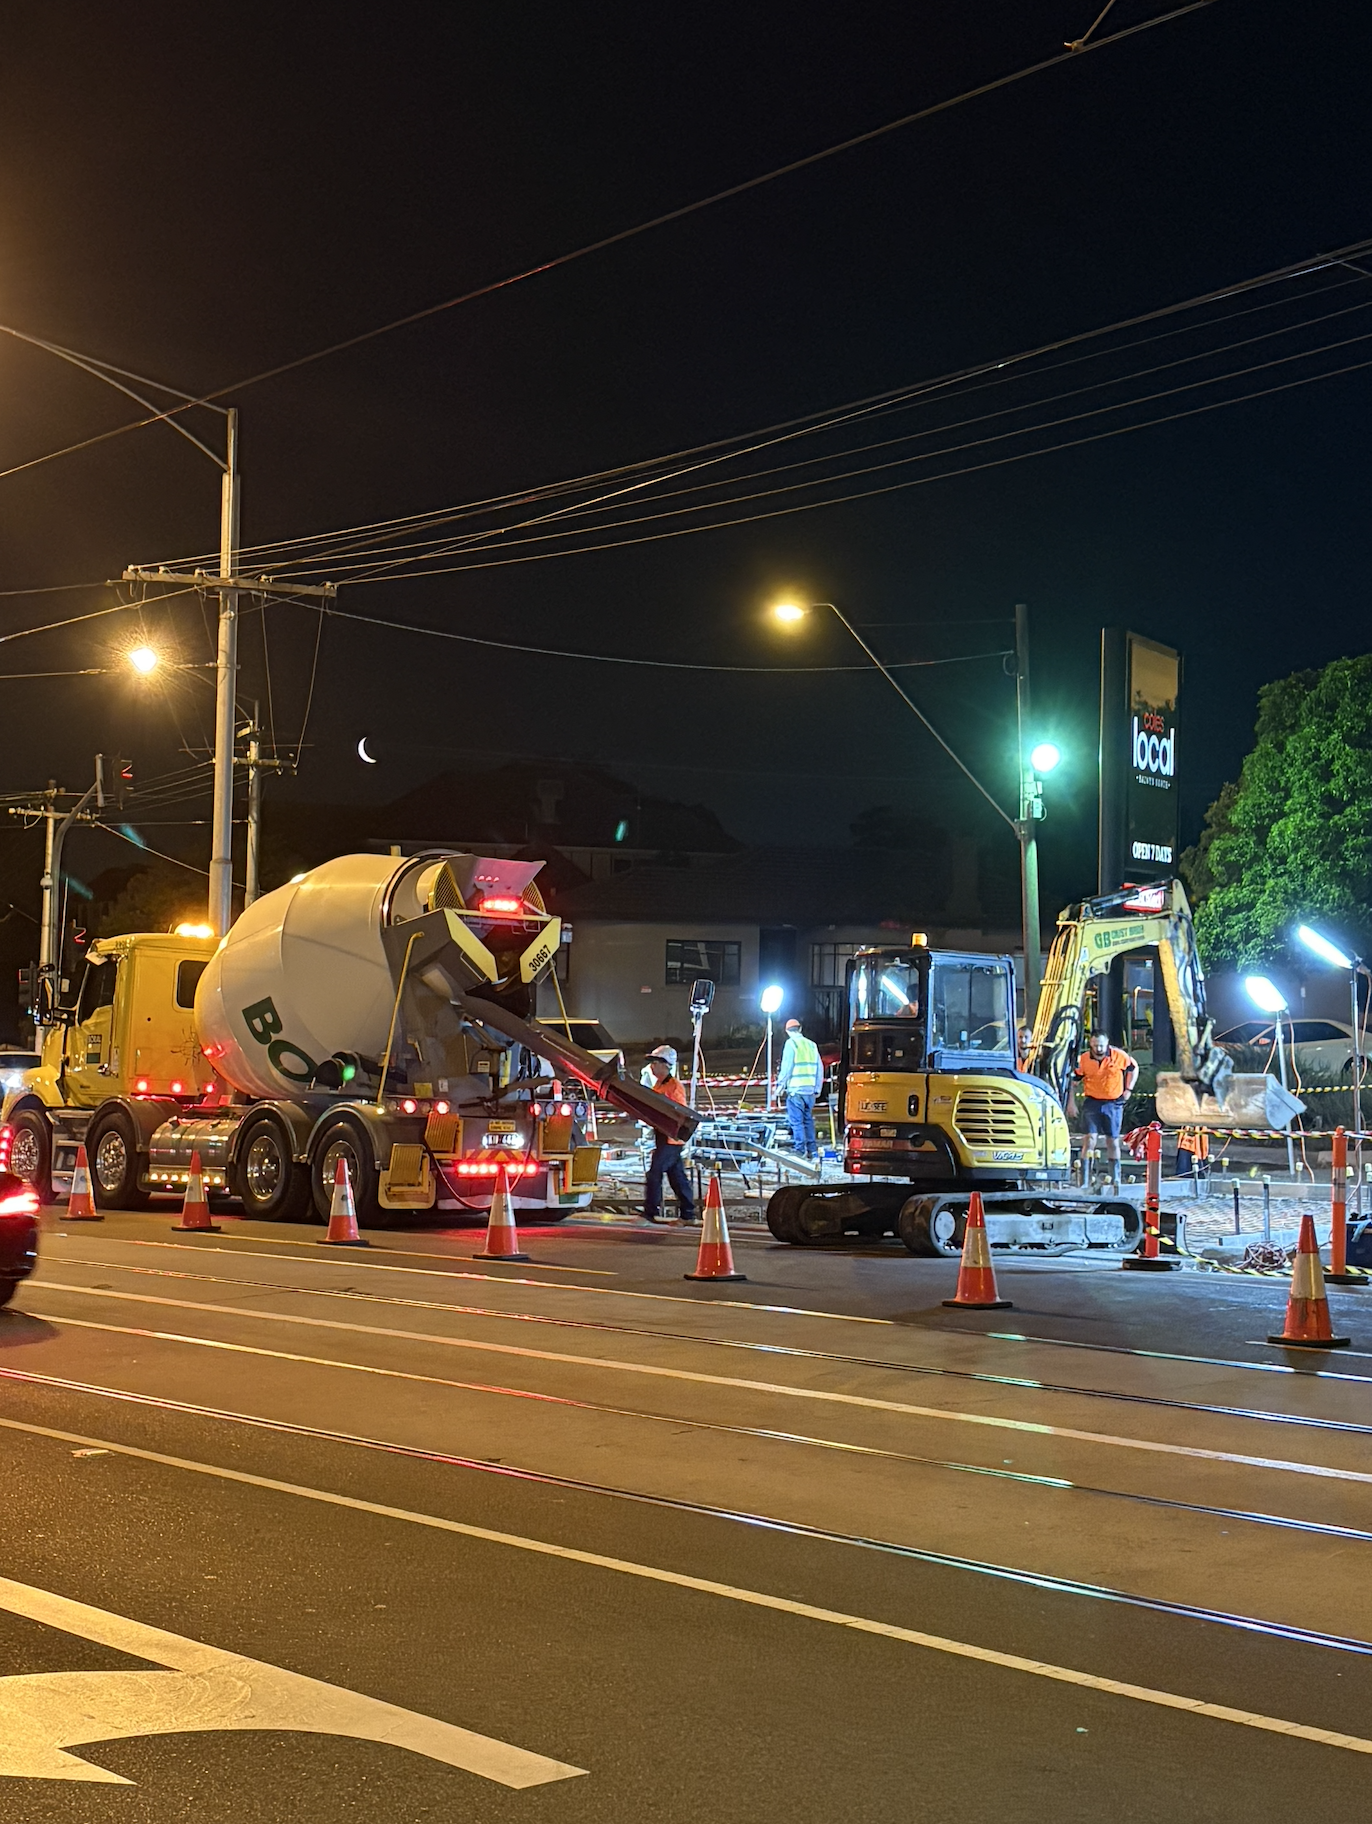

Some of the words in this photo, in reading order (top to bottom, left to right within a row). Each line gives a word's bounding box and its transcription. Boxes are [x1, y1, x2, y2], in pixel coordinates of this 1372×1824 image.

[1143, 710, 1164, 733] coles
[1133, 716, 1175, 776] local
[1132, 841, 1151, 861] OPEN
[1151, 844, 1156, 861] 7
[1155, 844, 1173, 864] DAYS
[1095, 931, 1112, 949] GB
[528, 944, 552, 972] 30667
